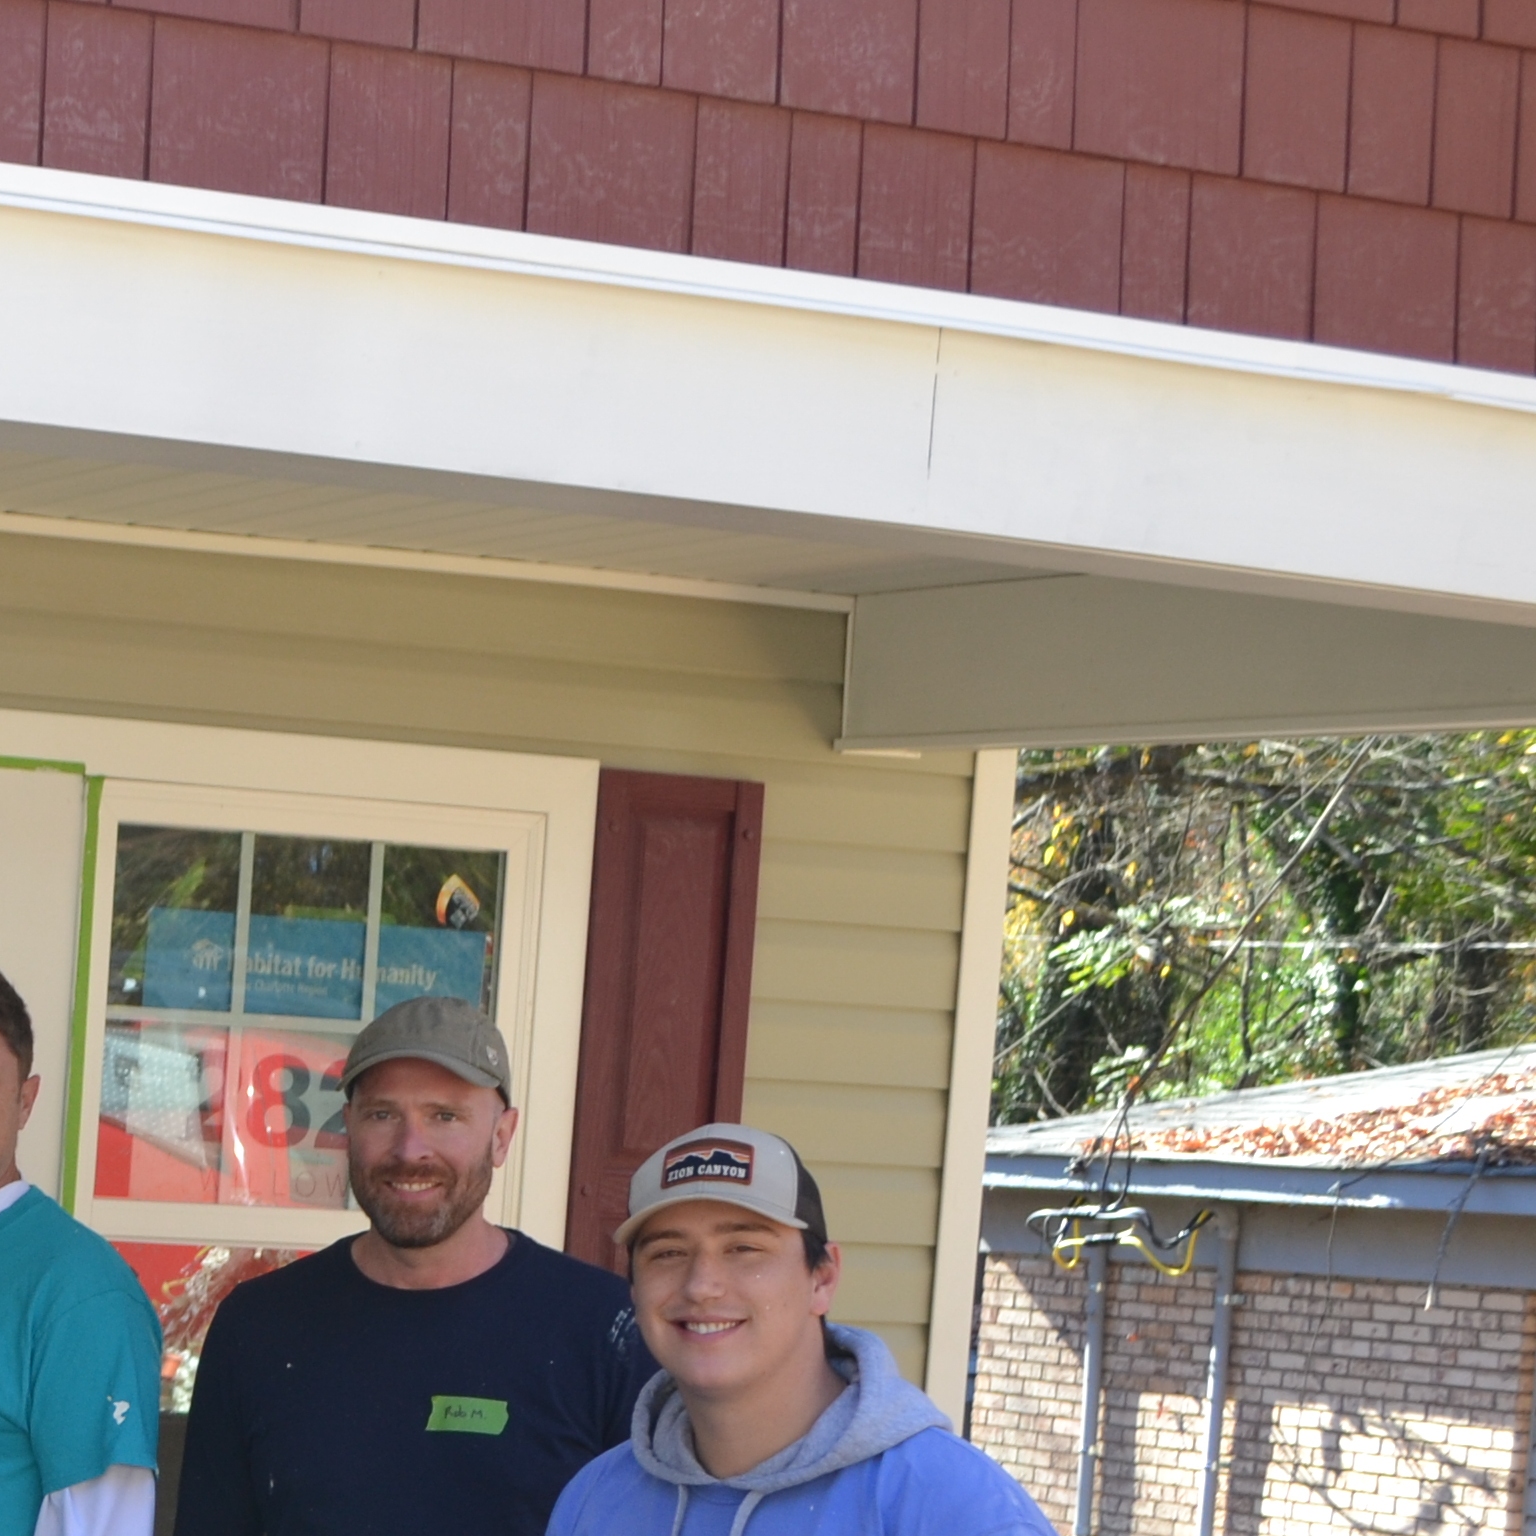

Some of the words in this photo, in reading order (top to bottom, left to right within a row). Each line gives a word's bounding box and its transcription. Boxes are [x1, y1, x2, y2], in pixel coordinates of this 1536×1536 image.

[308, 955, 335, 980] for
[666, 1164, 695, 1183] ZION
[697, 1163, 747, 1179] CANYON
[443, 1404, 467, 1420] Rob
